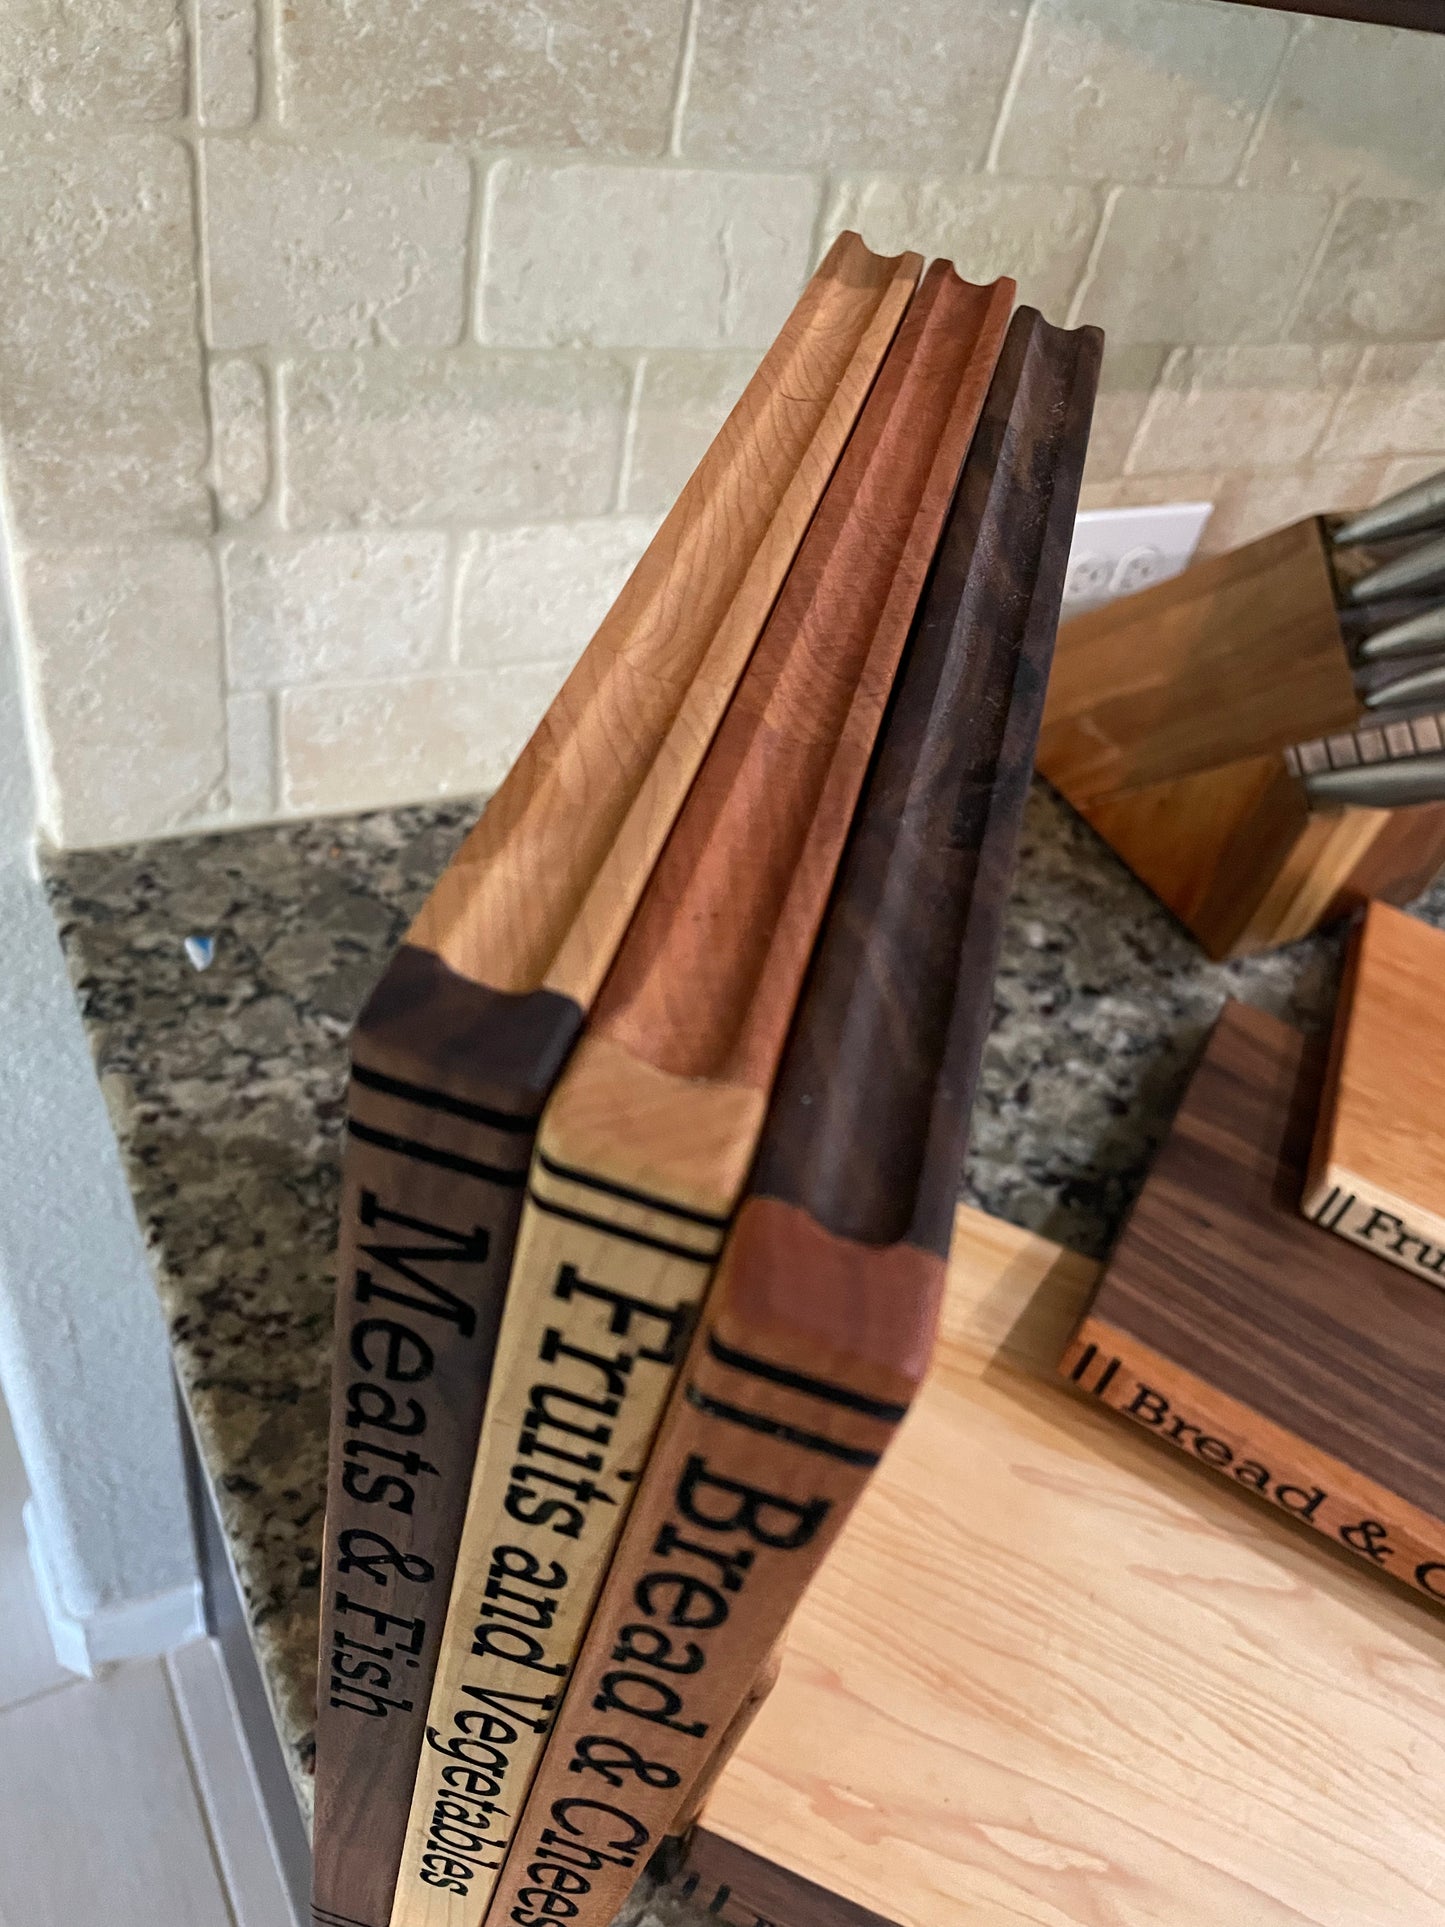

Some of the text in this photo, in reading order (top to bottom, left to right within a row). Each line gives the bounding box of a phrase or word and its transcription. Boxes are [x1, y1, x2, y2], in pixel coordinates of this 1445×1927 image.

[329, 1189, 490, 1719] Meats & Fish
[419, 1262, 690, 1897] Fruits and Vegetables
[1121, 1382, 1328, 1522] Bread
[1339, 1519, 1394, 1564] &
[592, 1457, 832, 1739] Bread
[568, 1734, 681, 1789] &
